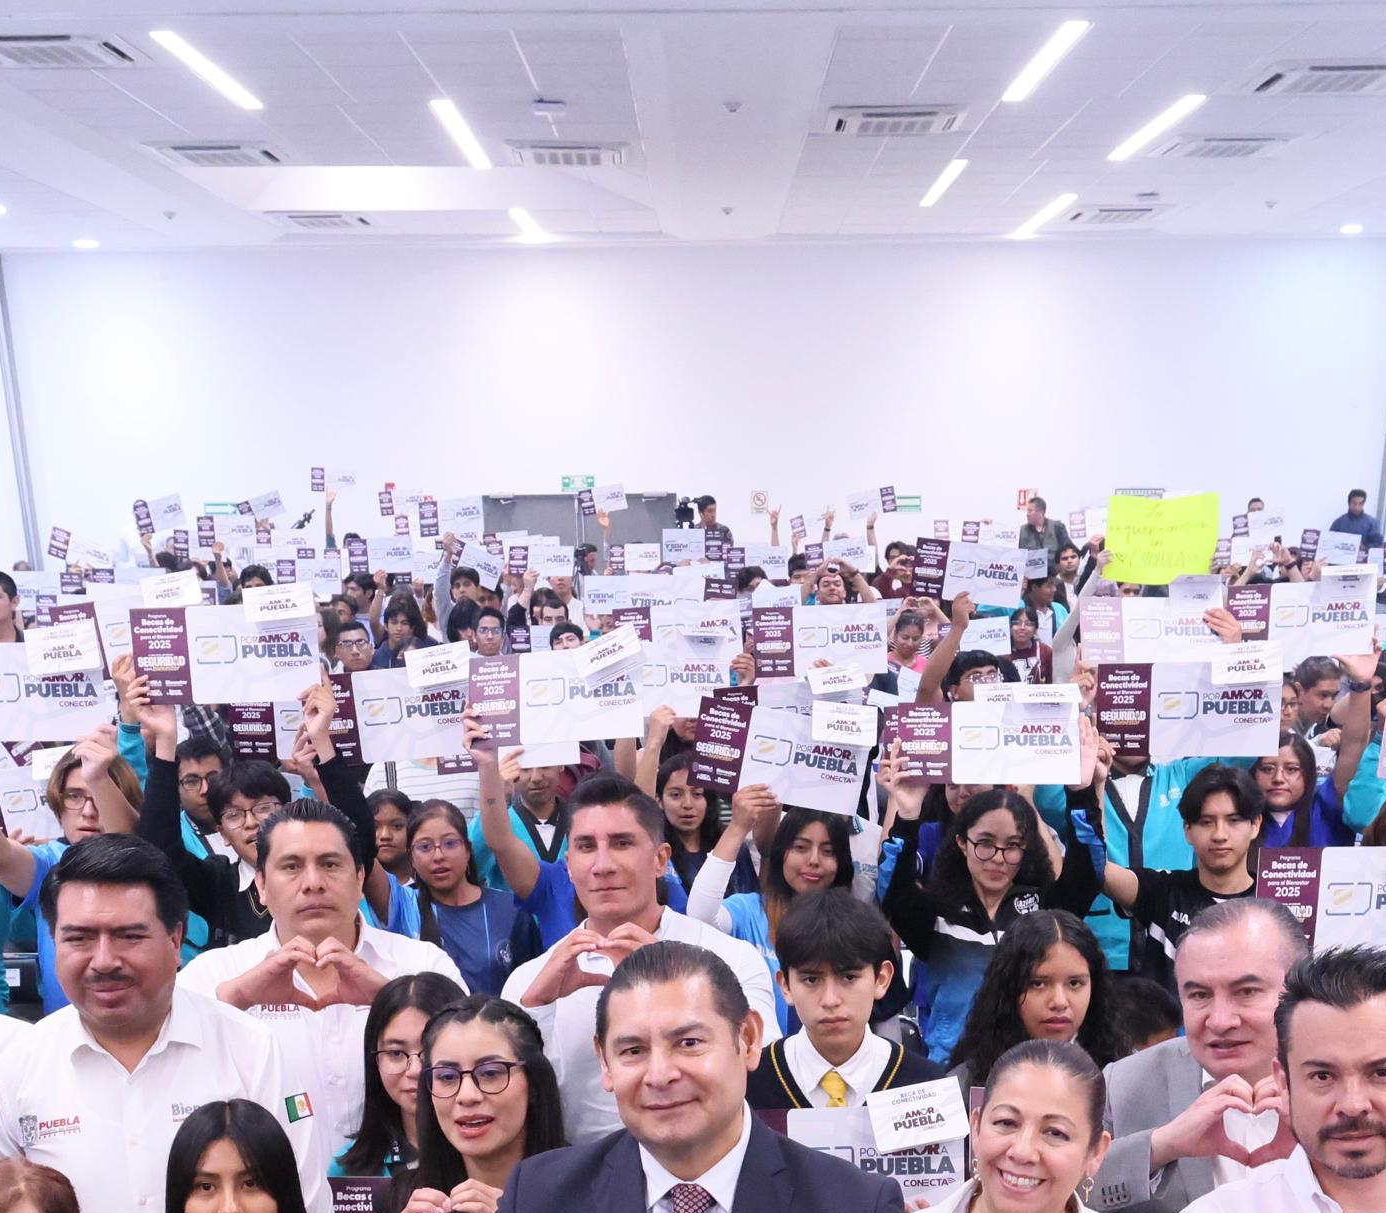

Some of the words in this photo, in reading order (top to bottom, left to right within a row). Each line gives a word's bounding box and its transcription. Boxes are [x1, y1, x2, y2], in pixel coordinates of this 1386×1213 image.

[844, 624, 873, 632] AMOR
[258, 632, 300, 643] AMOR
[832, 632, 882, 643] PUEBLA
[148, 640, 171, 649] 2025
[242, 643, 312, 658] PUEBLA
[25, 683, 97, 697] PUEBLA
[483, 686, 504, 695] 2025
[1220, 689, 1263, 699] AMOR
[1113, 696, 1134, 704] 2025
[1203, 701, 1273, 714] PUEBLA
[710, 729, 731, 740] 2025
[1021, 725, 1062, 734] AMOR
[1004, 735, 1072, 746] PUEBLA
[813, 745, 851, 760] AMOR
[794, 752, 857, 775] PUEBLA
[821, 773, 852, 783] CONECTA
[1272, 861, 1296, 869] Becas
[1297, 861, 1308, 869] de
[1262, 870, 1316, 878] Conectividad
[1275, 887, 1300, 897] 2025
[905, 1107, 934, 1118] AMOR
[38, 1115, 81, 1130] PUEBLA
[893, 1113, 945, 1131] PUEBLA
[860, 1156, 955, 1175] PUEBLA
[904, 1179, 949, 1187] CONECTA
[337, 1192, 366, 1200] Becas
